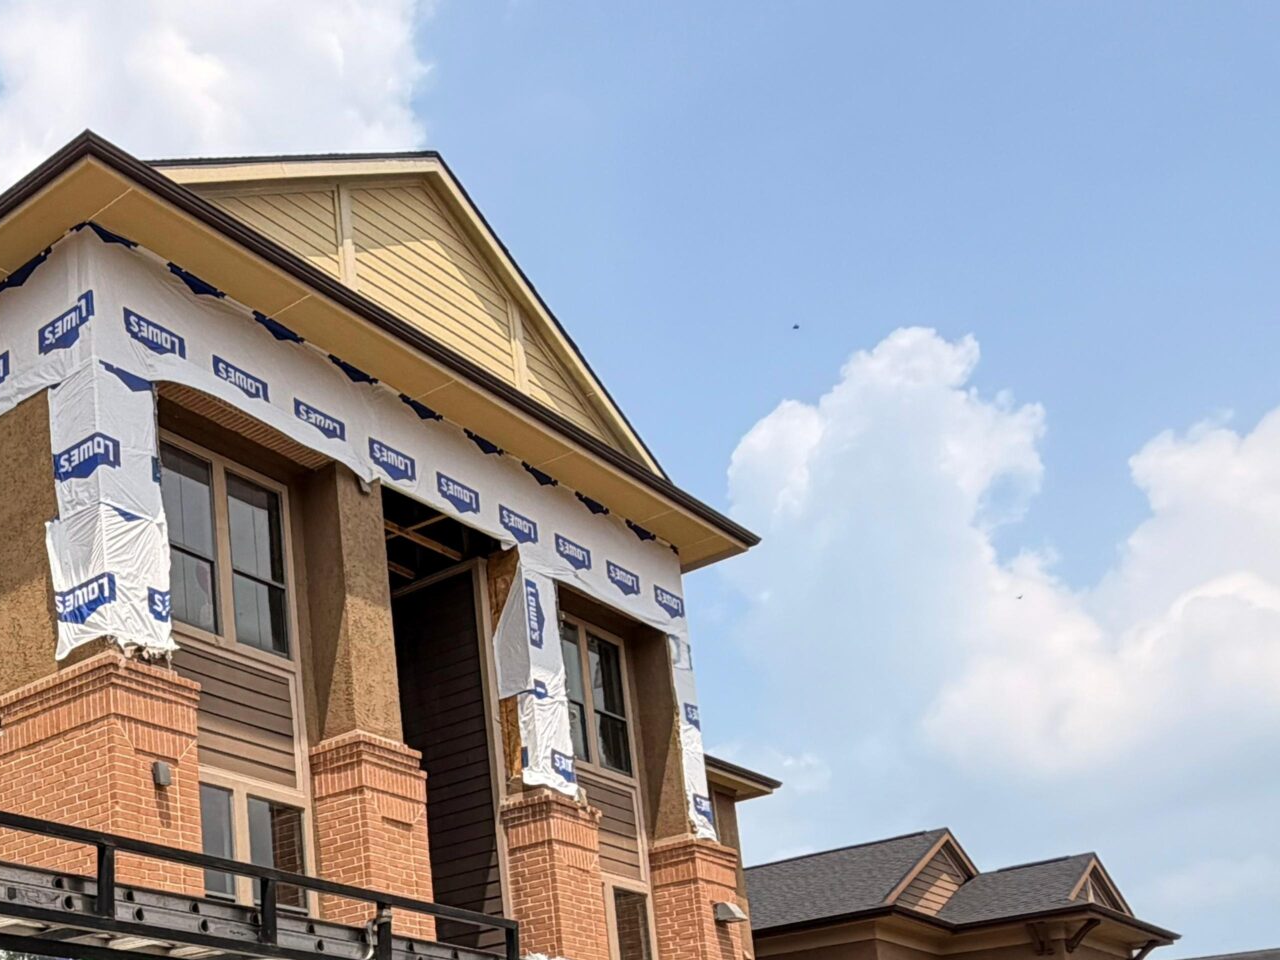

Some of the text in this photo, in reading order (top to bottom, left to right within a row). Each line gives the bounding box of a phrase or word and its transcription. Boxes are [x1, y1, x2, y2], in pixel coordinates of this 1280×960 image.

[129, 315, 180, 357] LOWE'S
[218, 362, 264, 403] LOWE'S
[59, 437, 114, 473] LOWE'S
[373, 443, 412, 477] LOWE'S
[441, 477, 476, 509] LOWE'S
[502, 509, 535, 539] LOWE'S
[558, 538, 589, 566] LOWE'S
[56, 576, 109, 615] LOWE'S
[609, 564, 638, 592] LOWE'S
[526, 586, 541, 645] LOWE'S
